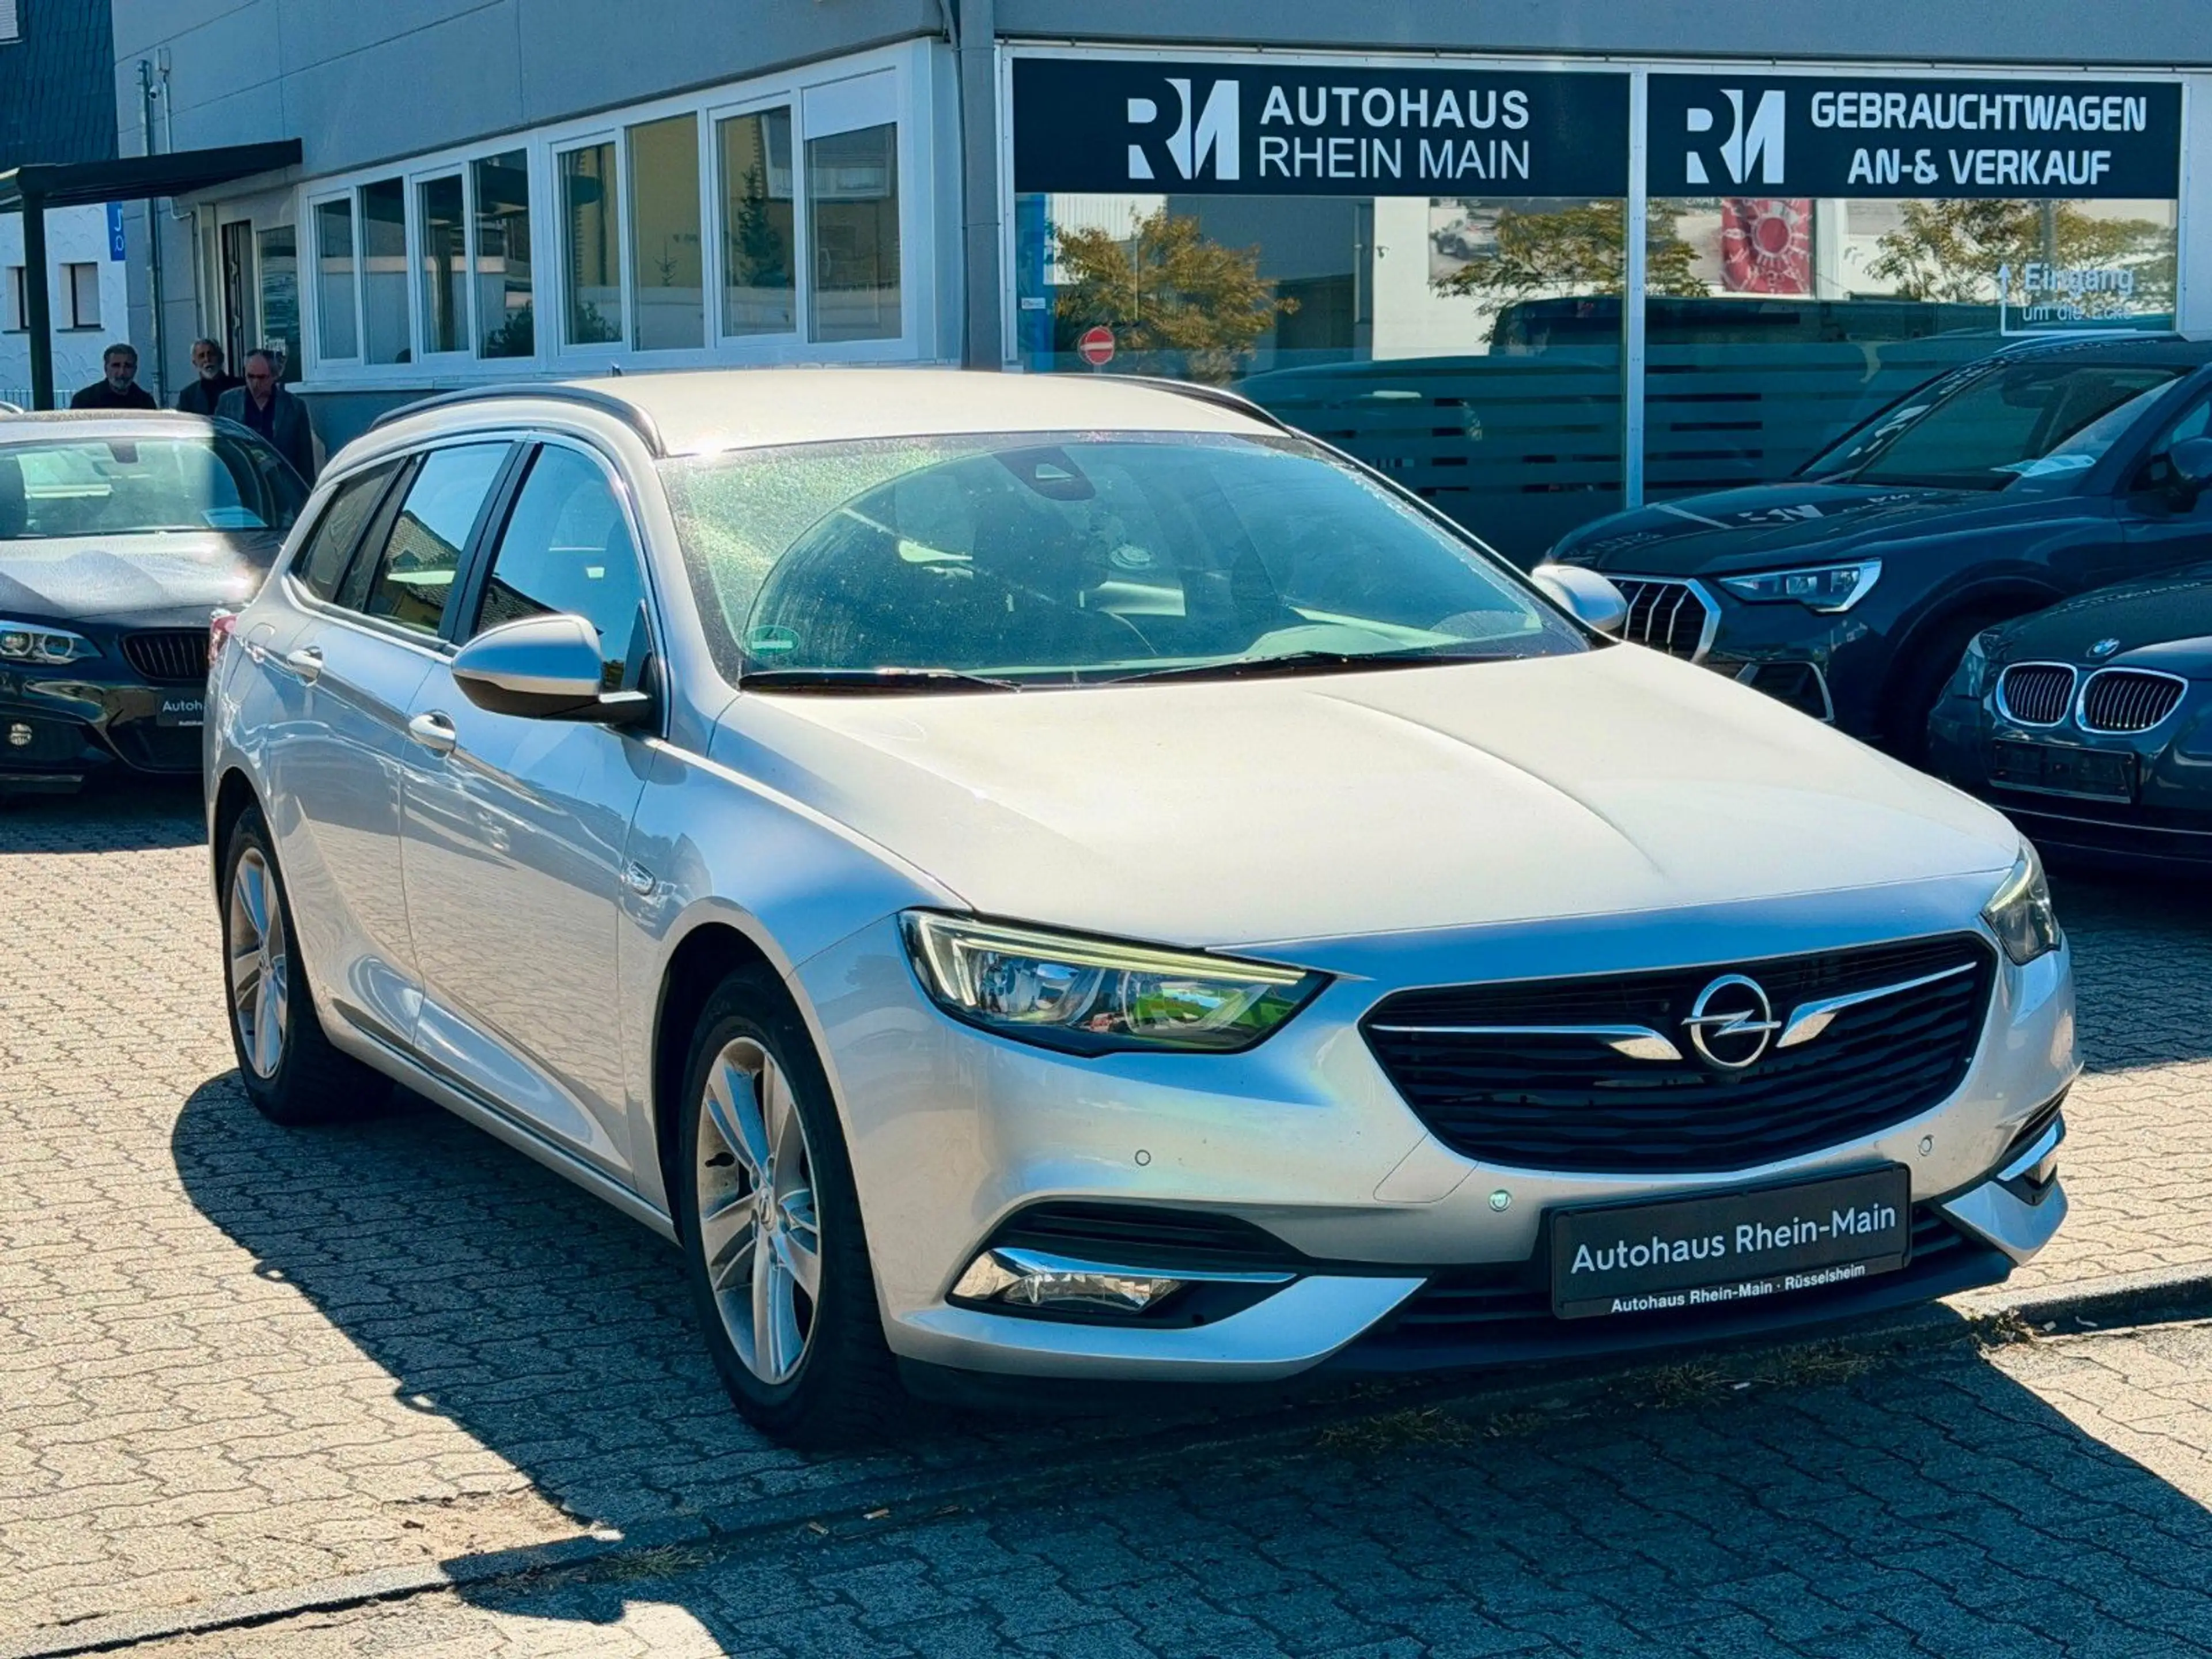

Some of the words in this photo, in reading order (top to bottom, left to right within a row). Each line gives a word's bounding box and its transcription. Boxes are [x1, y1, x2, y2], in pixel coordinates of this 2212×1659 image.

[1127, 78, 1240, 180] RM
[1260, 86, 1529, 130] AUTOHAUS
[1811, 91, 2147, 131] GEBRAUCHTWAGEN
[1686, 89, 1786, 184] RM
[1259, 137, 1402, 179] RHEIN
[1419, 139, 1529, 180] MAIN
[1847, 147, 1940, 184] AN-&
[1948, 149, 2112, 185] VERKAUF
[2024, 263, 2134, 297] Eingang
[2022, 306, 2048, 321] um
[2058, 304, 2082, 320] die
[162, 699, 204, 713] Autoh
[1570, 1235, 1726, 1274] Autohaus
[1736, 1202, 1896, 1253] Rhein-Main
[1611, 1294, 1685, 1313] Autohaus
[1690, 1281, 1772, 1305] Rhein-Main
[1785, 1264, 1866, 1290] Rüsselsheim
